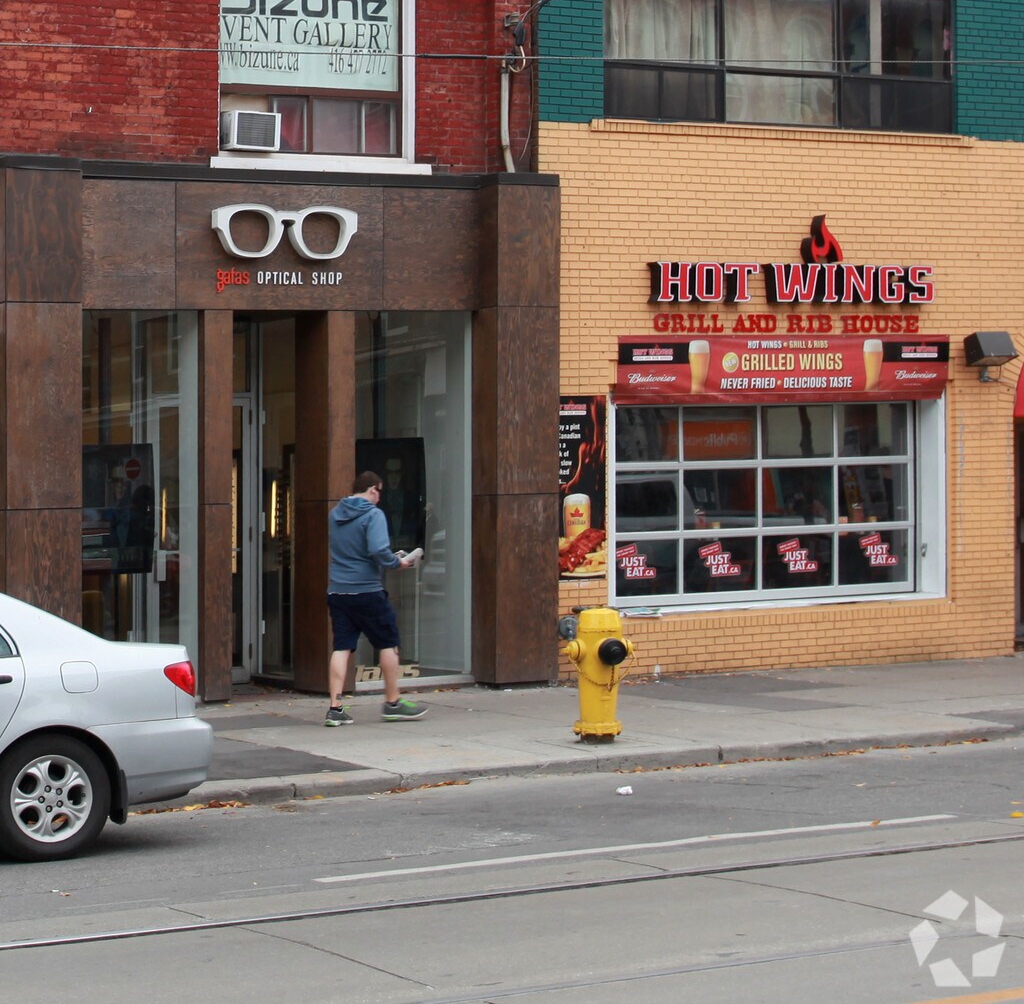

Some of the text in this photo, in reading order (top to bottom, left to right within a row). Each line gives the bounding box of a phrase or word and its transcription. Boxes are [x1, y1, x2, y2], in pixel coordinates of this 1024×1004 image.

[293, 19, 392, 50] GALLERY
[217, 268, 343, 293] gafas OPTICAL SHOP
[654, 261, 935, 304] HOT WINGS
[653, 314, 919, 334] GRILL AND RIB HOUSE
[747, 340, 760, 349] HOT
[761, 340, 782, 349] WINGS
[789, 340, 808, 349] GRILL
[814, 340, 829, 349] RIBS
[742, 353, 795, 371] GRILLED
[799, 353, 843, 371] WINGS
[628, 373, 676, 383] Budweiser
[895, 370, 937, 380] Budweiser
[720, 376, 852, 389] NEVER FRIED DELICIOUS TASTE
[865, 545, 887, 555] JUST
[706, 554, 729, 565] JUST
[784, 550, 806, 561] JUST
[871, 555, 896, 565] EAT.CA
[621, 557, 645, 567] JUST
[789, 561, 816, 571] EAT.CA
[626, 567, 654, 576] EAT.CA
[711, 565, 739, 575] EAT.CA
